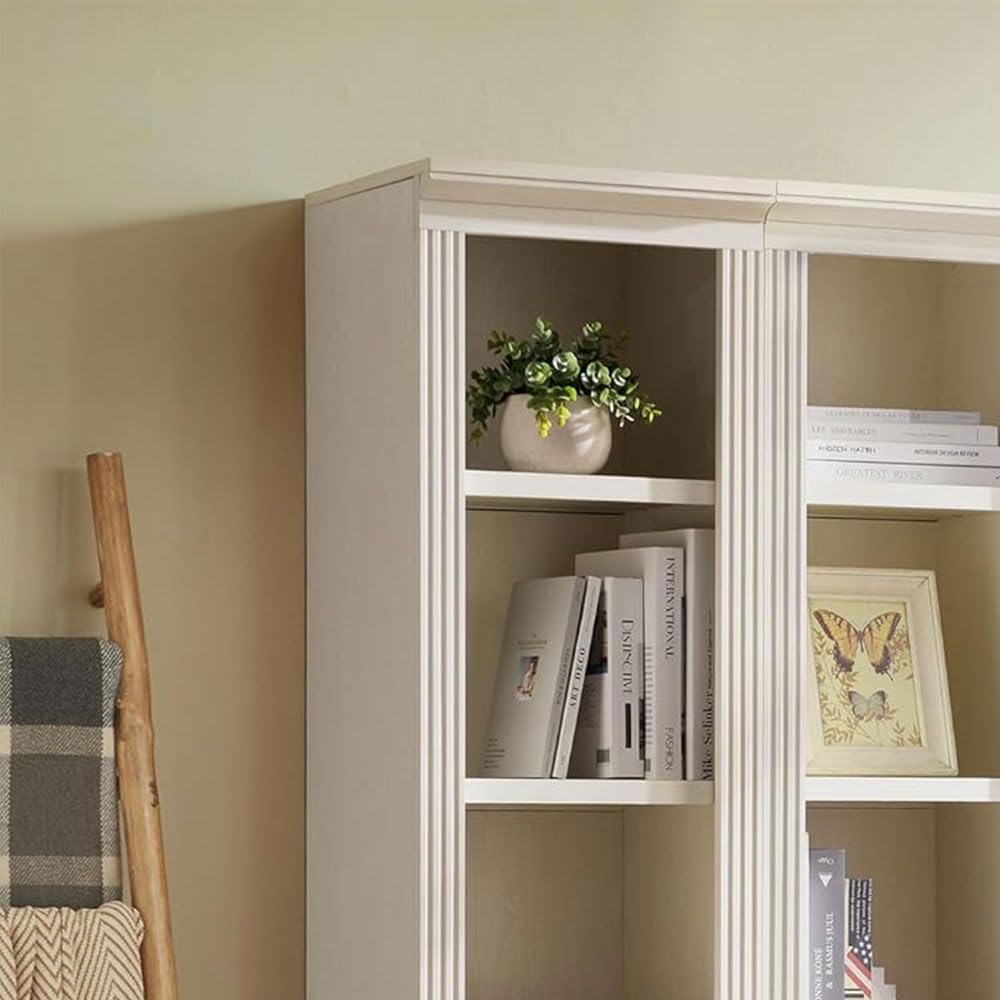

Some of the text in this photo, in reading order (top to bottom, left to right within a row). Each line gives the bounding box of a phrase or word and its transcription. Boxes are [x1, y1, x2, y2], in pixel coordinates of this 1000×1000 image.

[574, 646, 586, 681] DECO
[664, 557, 675, 772] INTERNATIONAL FASHION
[825, 936, 834, 976] RASMUS
